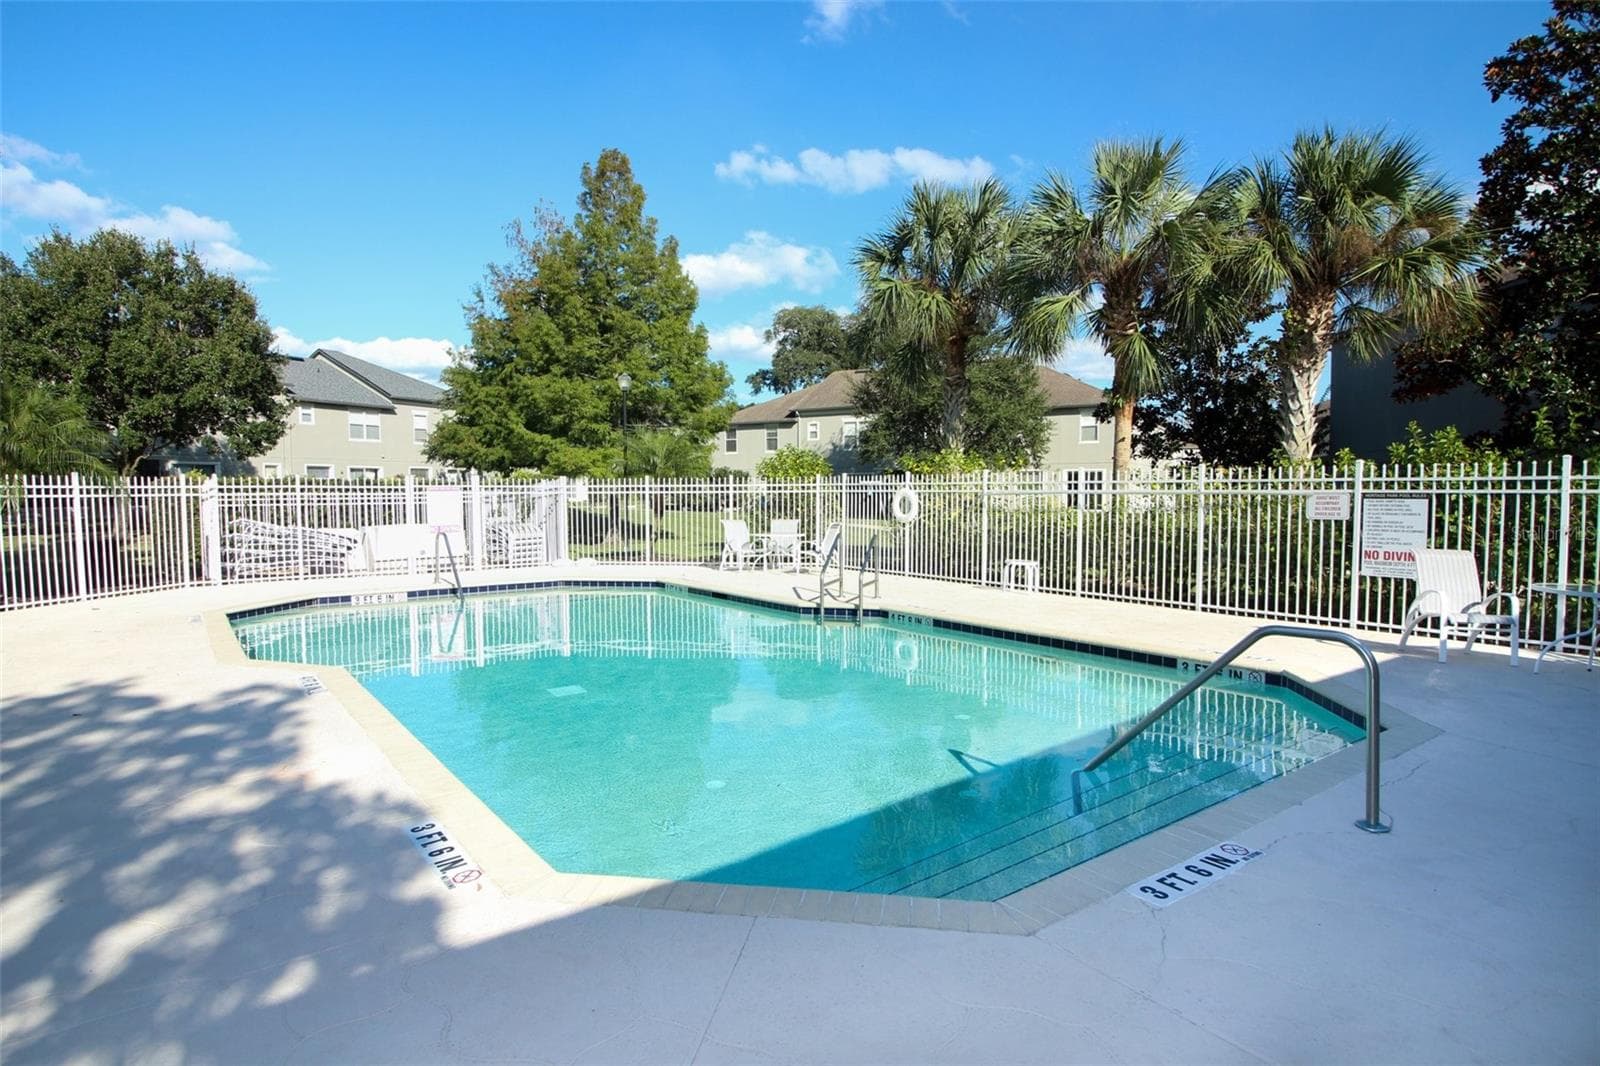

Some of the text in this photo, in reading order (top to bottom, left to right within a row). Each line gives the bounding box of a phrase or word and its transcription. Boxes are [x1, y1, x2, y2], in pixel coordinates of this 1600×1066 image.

[1364, 550, 1415, 561] NO DIVIN
[1229, 669, 1243, 679] IN
[410, 823, 436, 833] 3
[428, 846, 455, 857] 6
[1140, 885, 1169, 899] 3
[1185, 865, 1213, 877] 6
